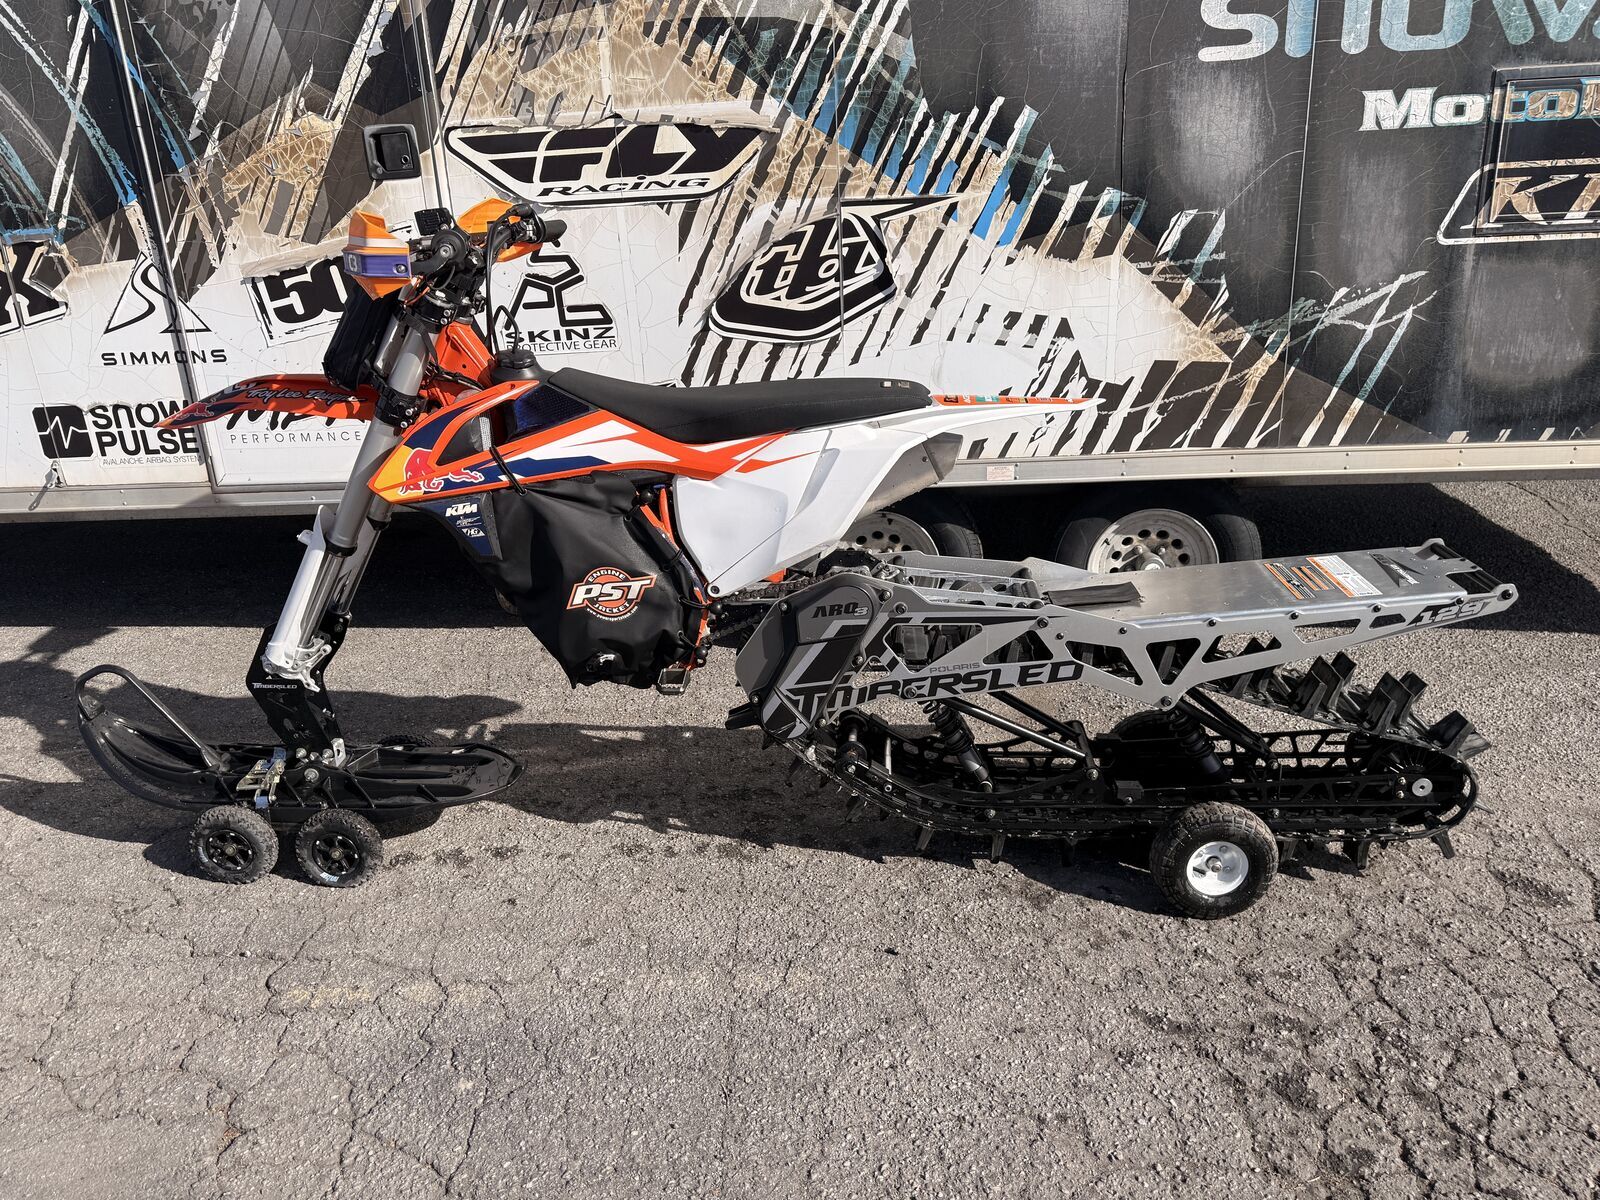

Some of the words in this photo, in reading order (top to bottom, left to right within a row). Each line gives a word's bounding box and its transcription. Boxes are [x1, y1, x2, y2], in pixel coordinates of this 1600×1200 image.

[456, 124, 765, 184] FLY
[505, 326, 616, 345] SKINZ
[583, 339, 617, 349] GEAR
[101, 349, 227, 366] SIMMONS
[95, 427, 200, 457] PULSE
[230, 431, 362, 444] PERFORMANCE
[102, 457, 144, 466] AVALANCHE
[146, 456, 173, 464] AIRBAG
[445, 502, 478, 517] KTM
[588, 569, 626, 582] ENGINE
[572, 580, 651, 605] PST
[593, 603, 630, 613] JACKET
[1415, 601, 1485, 626] 129
[929, 661, 981, 675] POLARIS
